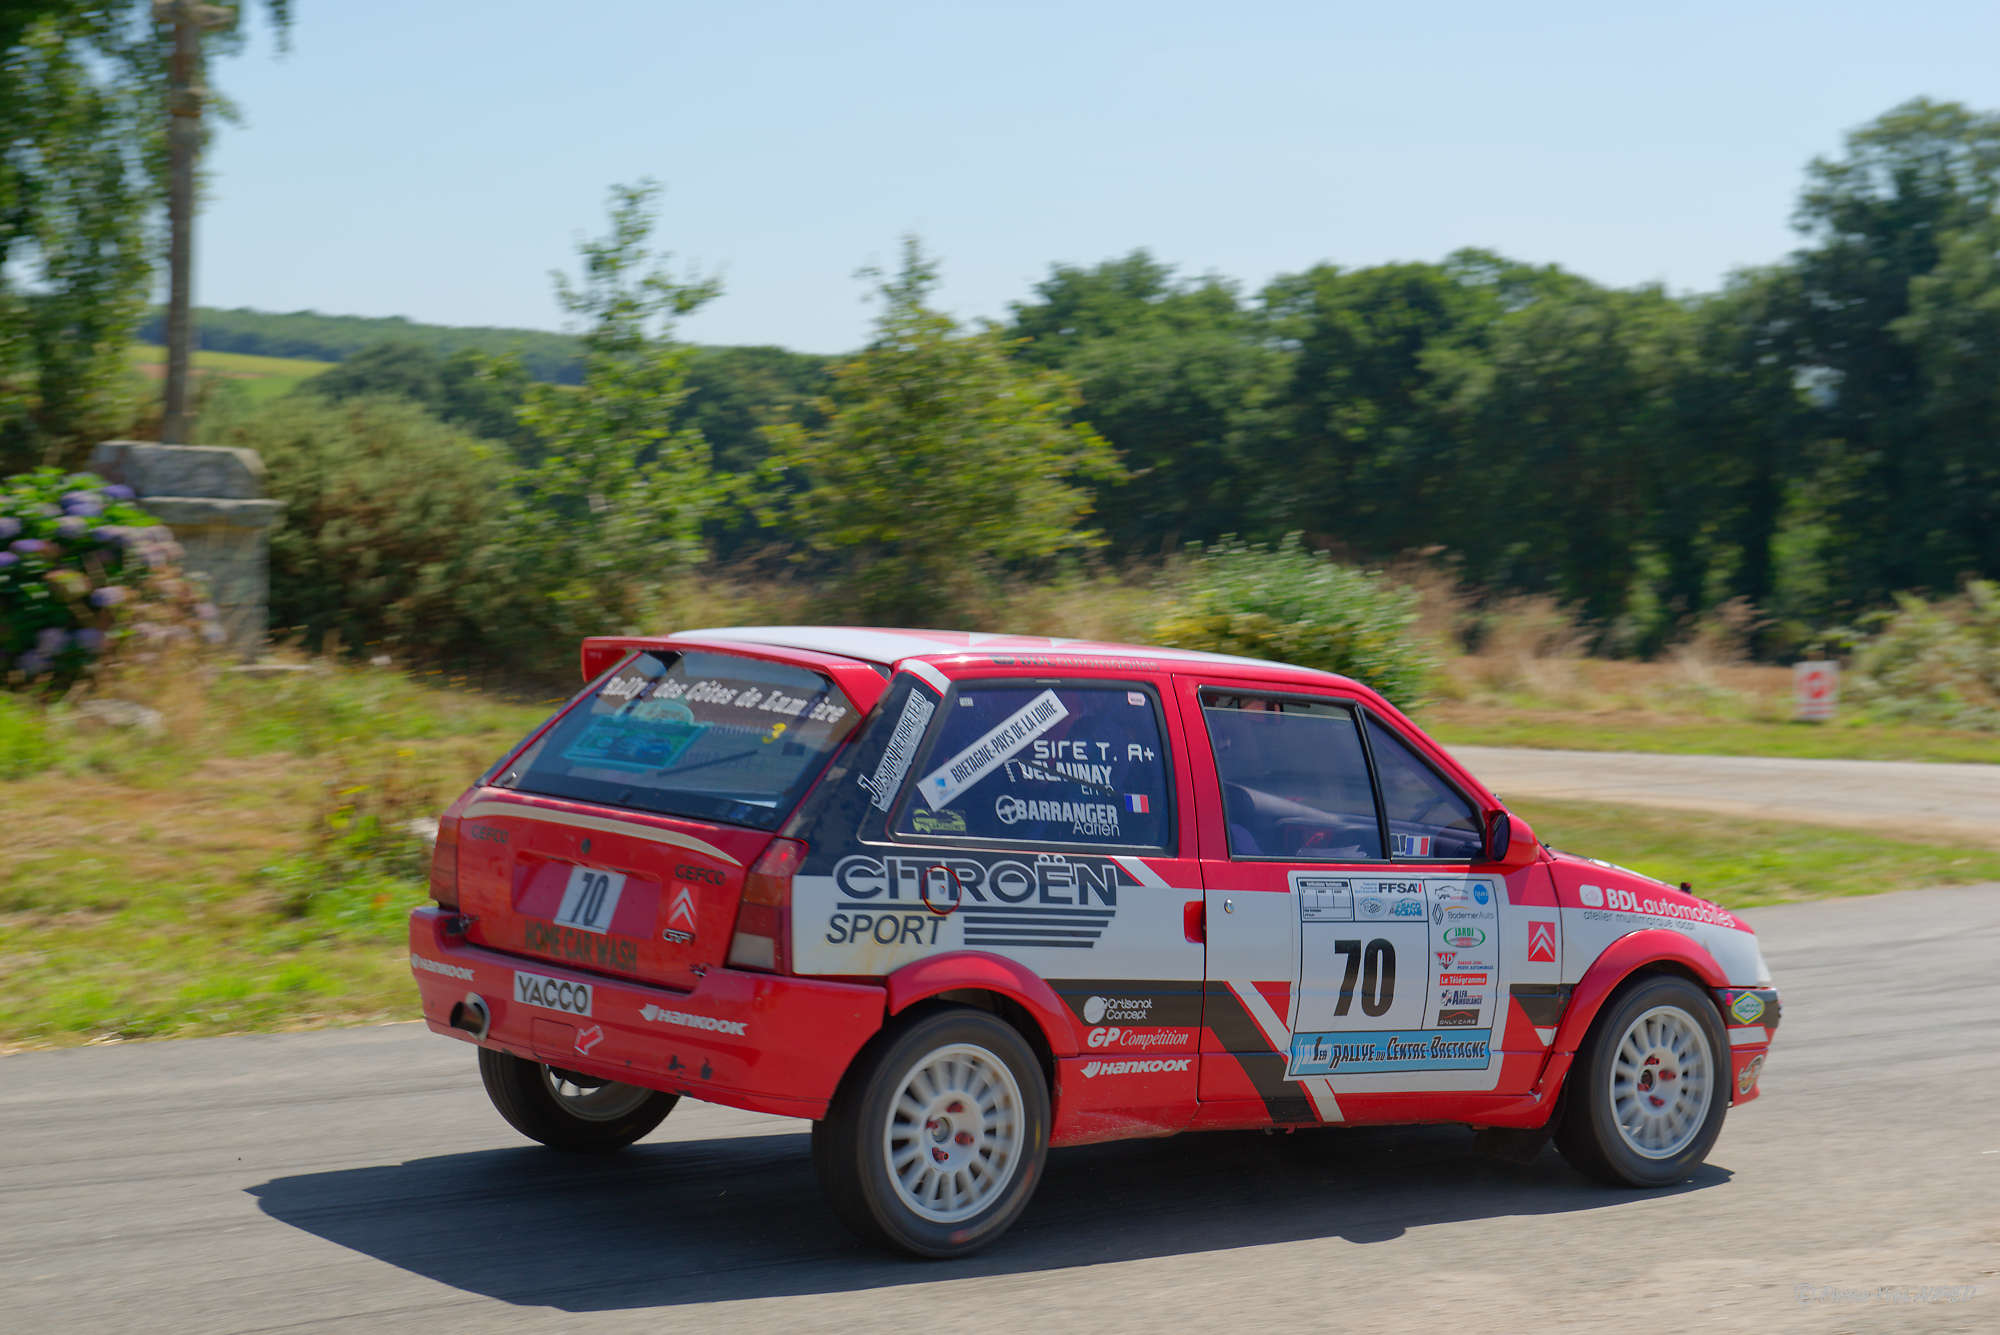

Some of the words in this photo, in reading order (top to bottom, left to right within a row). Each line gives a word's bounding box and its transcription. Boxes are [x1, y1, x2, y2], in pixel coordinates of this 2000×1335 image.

[1010, 721, 1027, 740] DE
[1020, 710, 1038, 732] LA
[1034, 699, 1058, 724] LOIRE
[1127, 743, 1155, 762] A+
[1016, 799, 1118, 824] BARRANGER
[1072, 820, 1121, 837] Adrien
[832, 854, 1118, 906] CITROËN
[1378, 882, 1417, 894] FFSA
[570, 871, 609, 927] 70
[826, 914, 946, 945] SPORT
[563, 929, 592, 963] CAR
[595, 937, 638, 975] WASH
[1333, 938, 1396, 1018] 70
[519, 975, 589, 1015] YACCO
[1106, 1009, 1147, 1021] Concept
[1087, 1027, 1121, 1048] GP
[1120, 1028, 1189, 1050] Compétition
